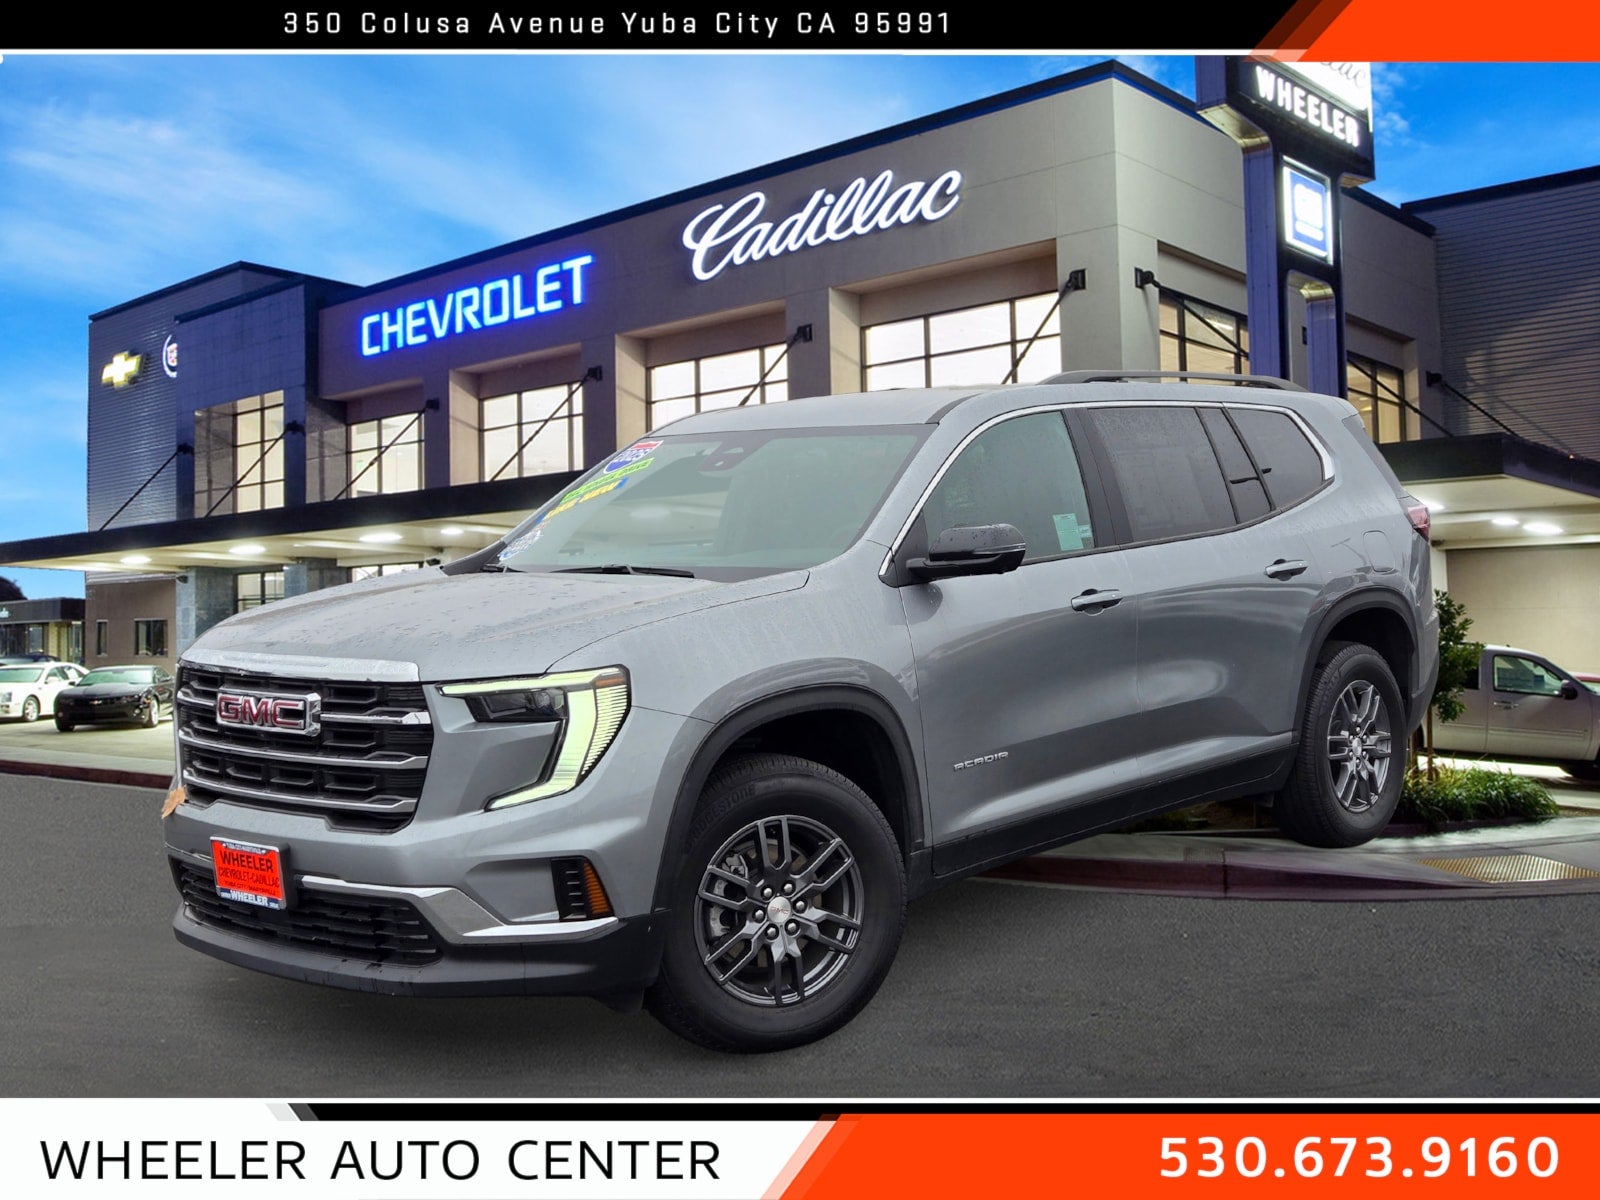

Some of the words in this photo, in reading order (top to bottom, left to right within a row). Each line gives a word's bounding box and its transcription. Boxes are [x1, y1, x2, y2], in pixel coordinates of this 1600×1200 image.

[1255, 65, 1360, 147] WHEELER
[682, 168, 964, 281] Cadillac
[359, 254, 596, 357] CHEVROLET
[217, 692, 307, 732] GMC
[953, 751, 1009, 771] ACADIA
[220, 850, 274, 873] WHEELER
[230, 889, 269, 907] WHEELER
